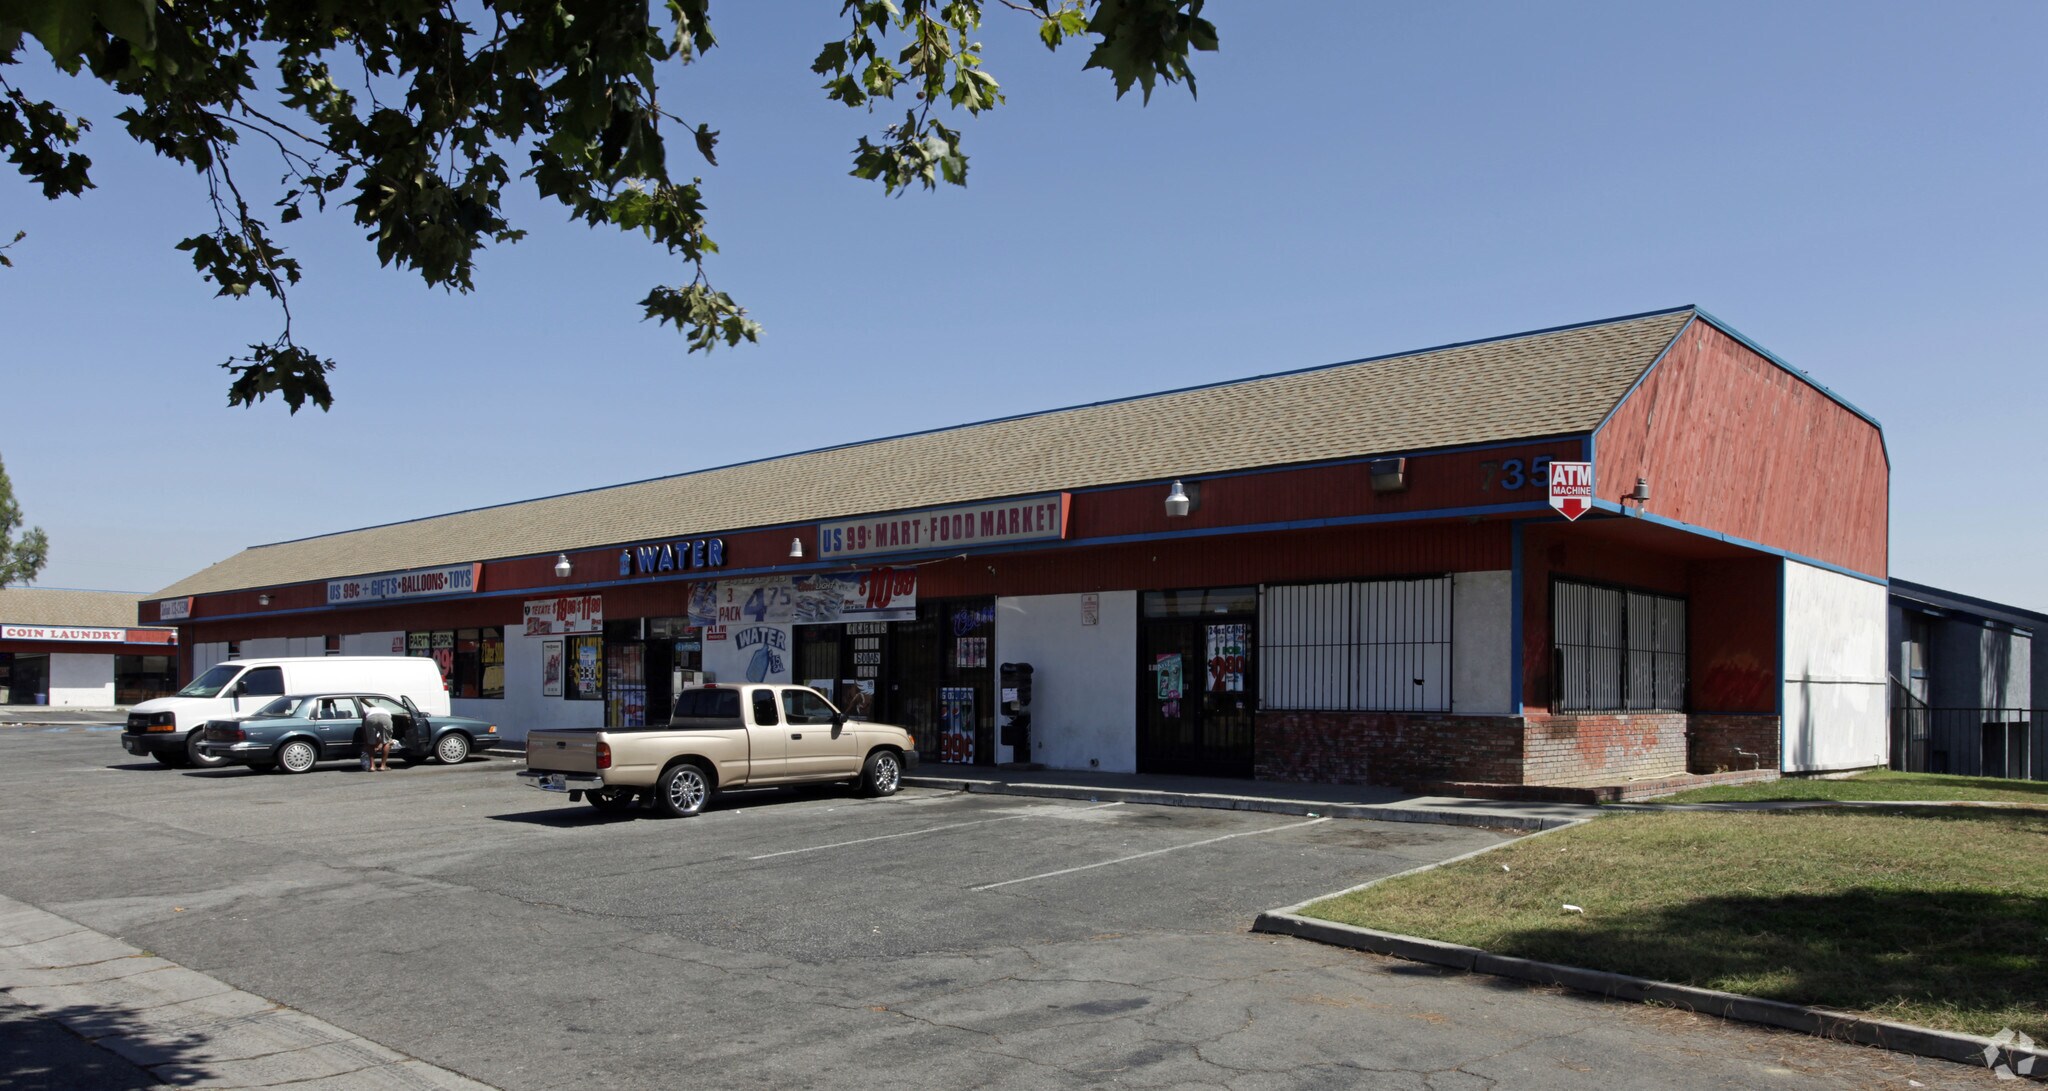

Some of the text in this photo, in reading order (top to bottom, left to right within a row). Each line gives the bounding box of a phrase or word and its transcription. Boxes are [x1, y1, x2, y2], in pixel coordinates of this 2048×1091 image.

[1553, 465, 1591, 485] ATM
[1553, 486, 1591, 495] MACHINE
[823, 528, 842, 552] US
[876, 519, 921, 547] MART
[930, 512, 975, 542] FOOD
[980, 503, 1057, 537] MARKET
[637, 538, 724, 574] WATER
[329, 584, 341, 600] US
[402, 572, 444, 593] BALLOONS
[448, 568, 472, 588] TOYS
[727, 588, 733, 603] 3
[532, 605, 552, 616] TECATE
[719, 605, 742, 622] PACK
[6, 628, 120, 640] COIN LAUNDRY
[707, 624, 726, 633] ATM
[409, 633, 454, 648] PARTY SUPPLY
[738, 627, 786, 651] WATER
